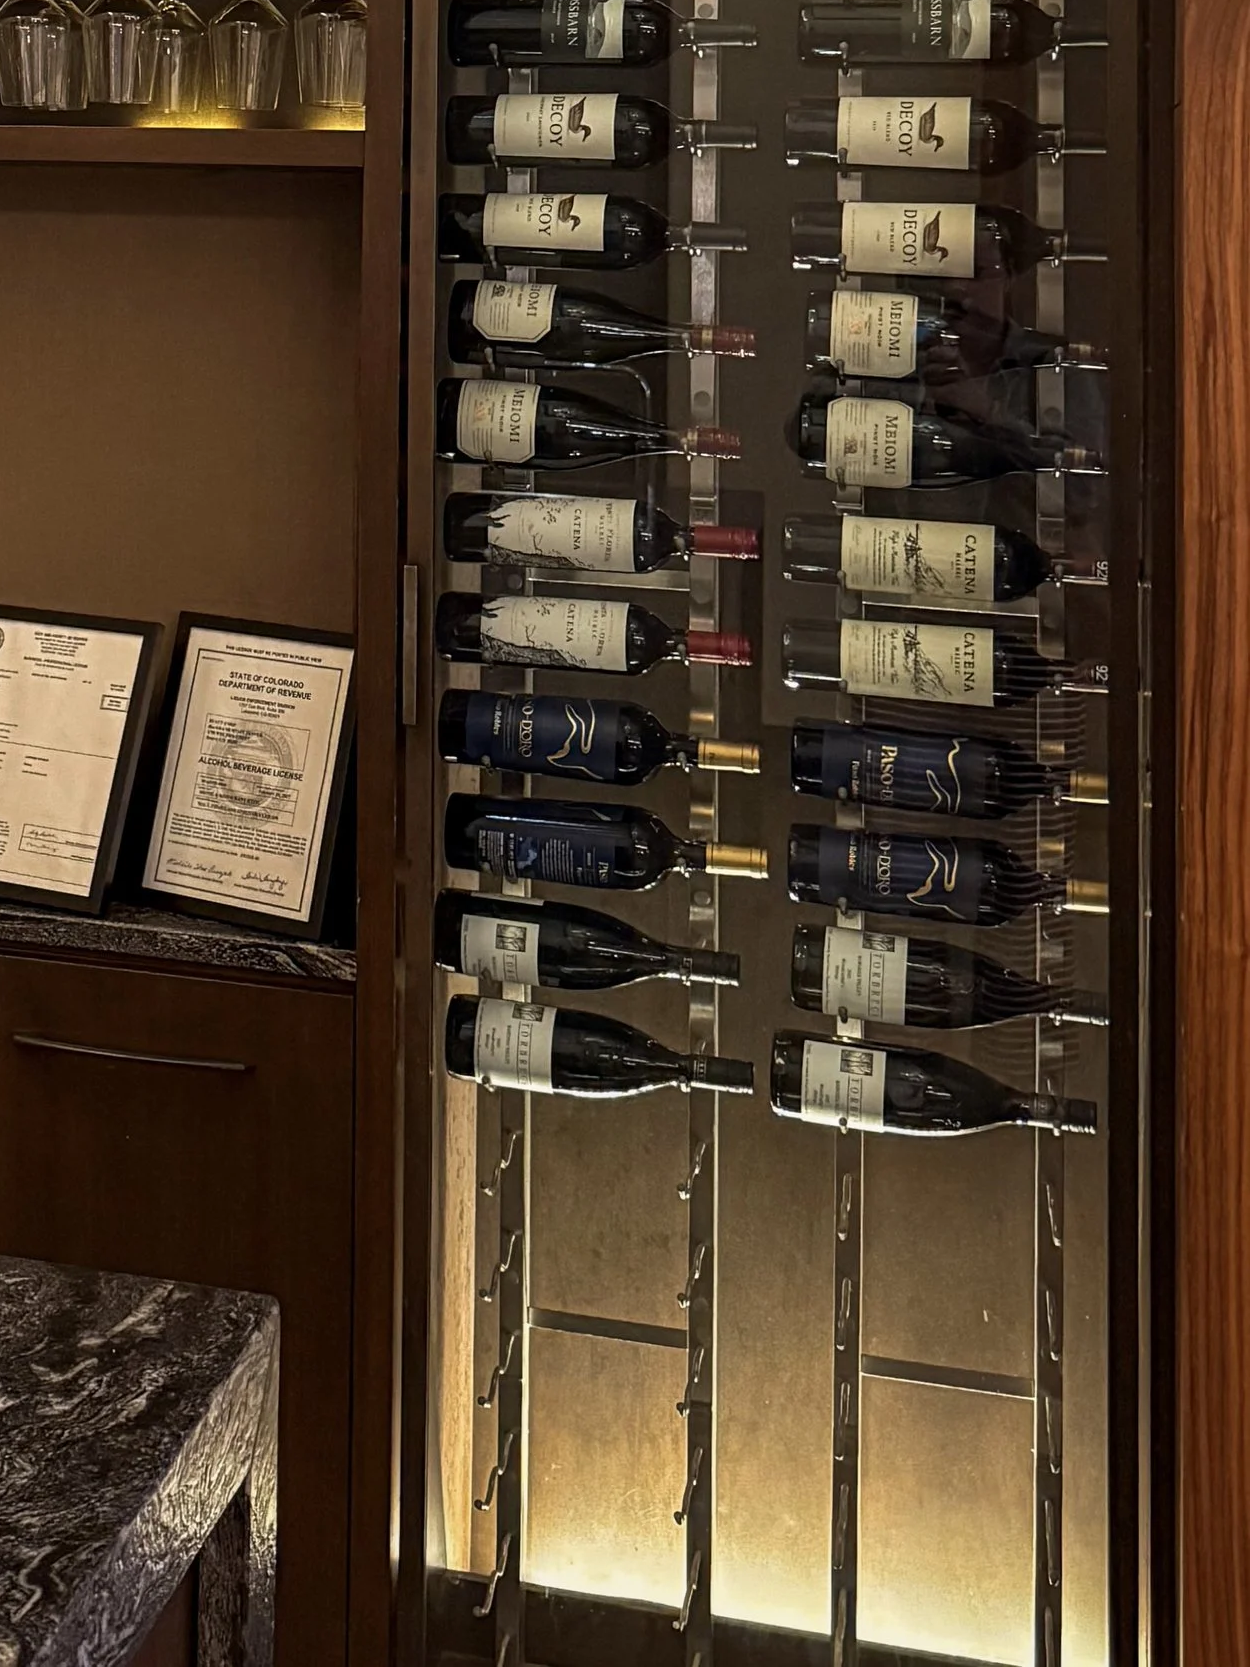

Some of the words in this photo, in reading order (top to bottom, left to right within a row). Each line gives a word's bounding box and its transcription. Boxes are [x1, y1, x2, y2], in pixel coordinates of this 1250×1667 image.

[549, 95, 565, 147] DECOY
[898, 101, 914, 156] DECOY
[539, 195, 554, 237] ECOY
[902, 209, 918, 266] DECOY
[527, 284, 542, 317] EIOMI
[889, 301, 904, 358] MEIOMI
[509, 388, 526, 444] MEIOMI
[884, 414, 898, 475] MEIOMI
[573, 508, 583, 550] CATENA
[964, 534, 976, 594] CATENA
[565, 603, 576, 643] CATENA
[229, 671, 251, 681] STATE
[252, 674, 263, 682] OF
[263, 676, 304, 689] COLORADO
[963, 632, 975, 692] CATENA
[1096, 665, 1108, 682] 92
[218, 679, 265, 693] DEPARTMENT
[266, 686, 276, 694] OF
[277, 689, 312, 700] REVENUE
[198, 756, 232, 769] ALCOHOL
[233, 762, 272, 776] BEVERAGE
[273, 770, 303, 781] LICENSE
